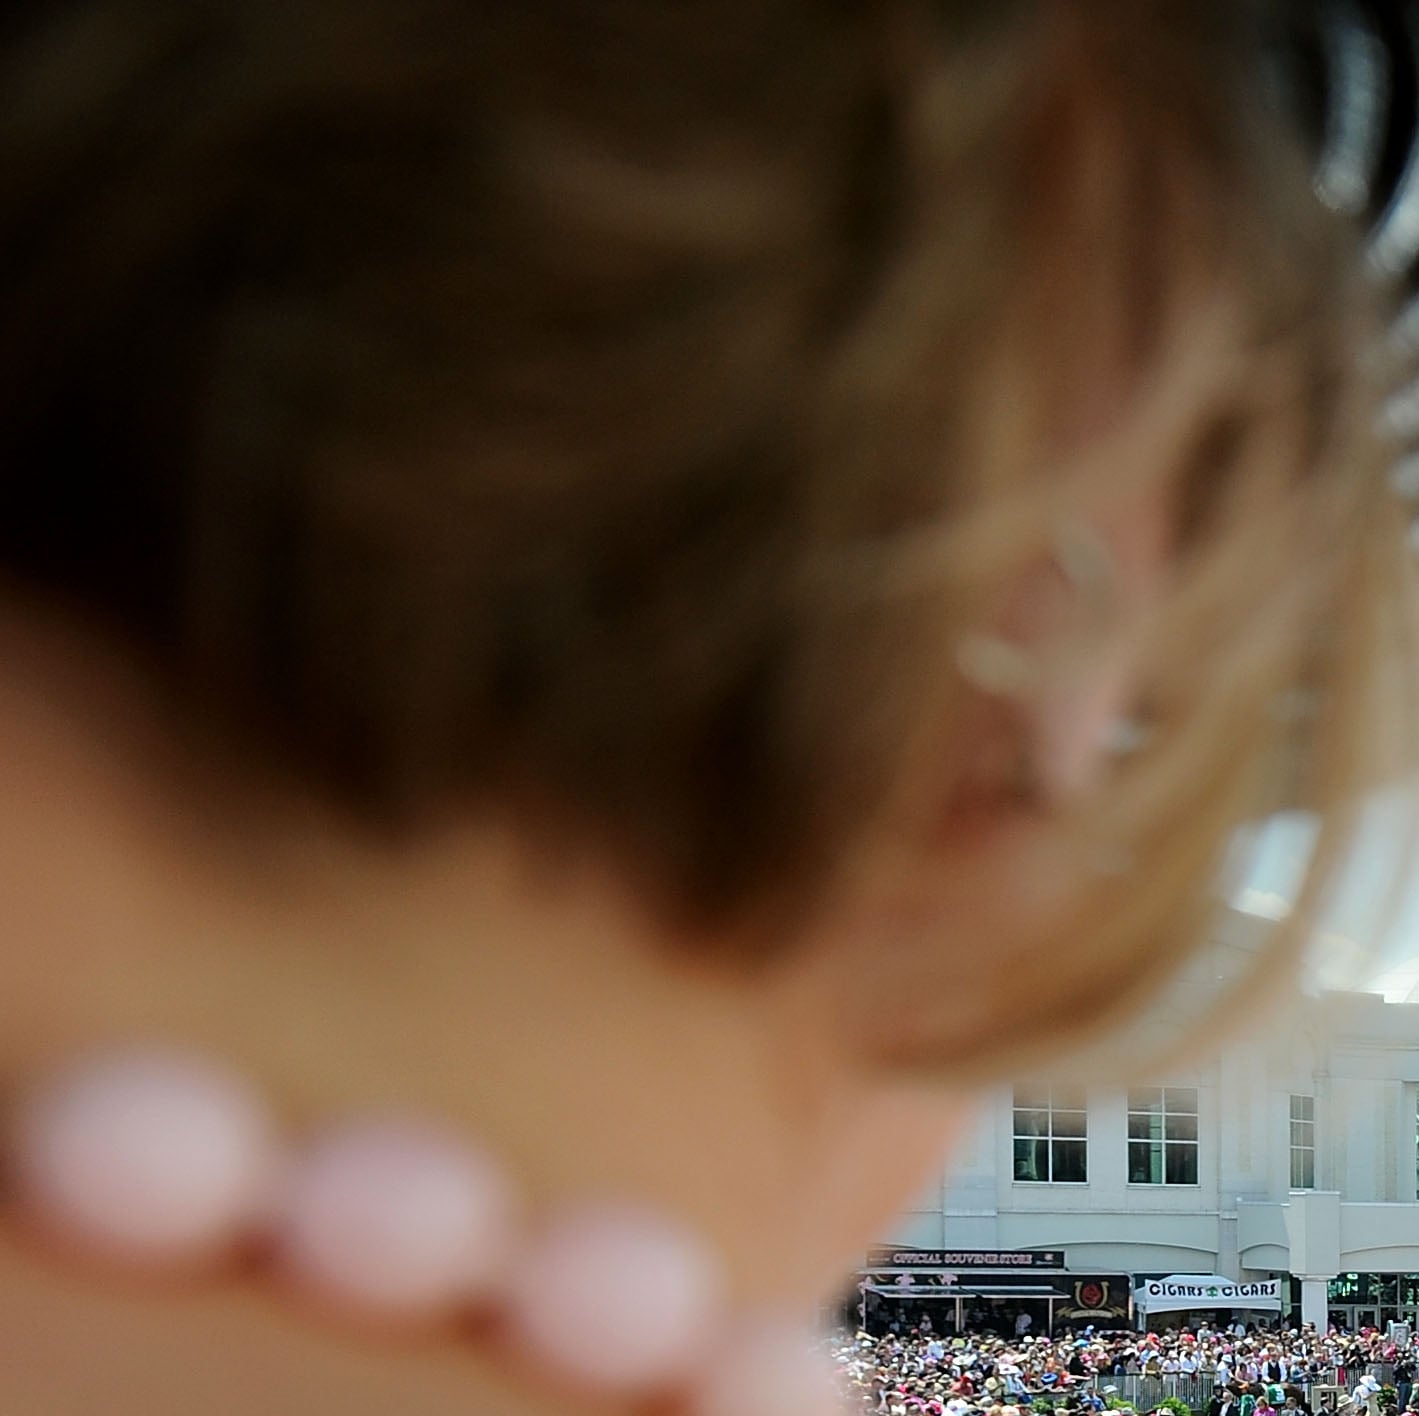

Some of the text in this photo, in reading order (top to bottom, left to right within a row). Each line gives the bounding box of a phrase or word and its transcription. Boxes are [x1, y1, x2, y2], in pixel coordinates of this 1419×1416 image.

[893, 1253, 943, 1265] OFFICIAL
[1000, 1253, 1034, 1265] STORE
[1149, 1282, 1277, 1297] CIGARS CIGARS
